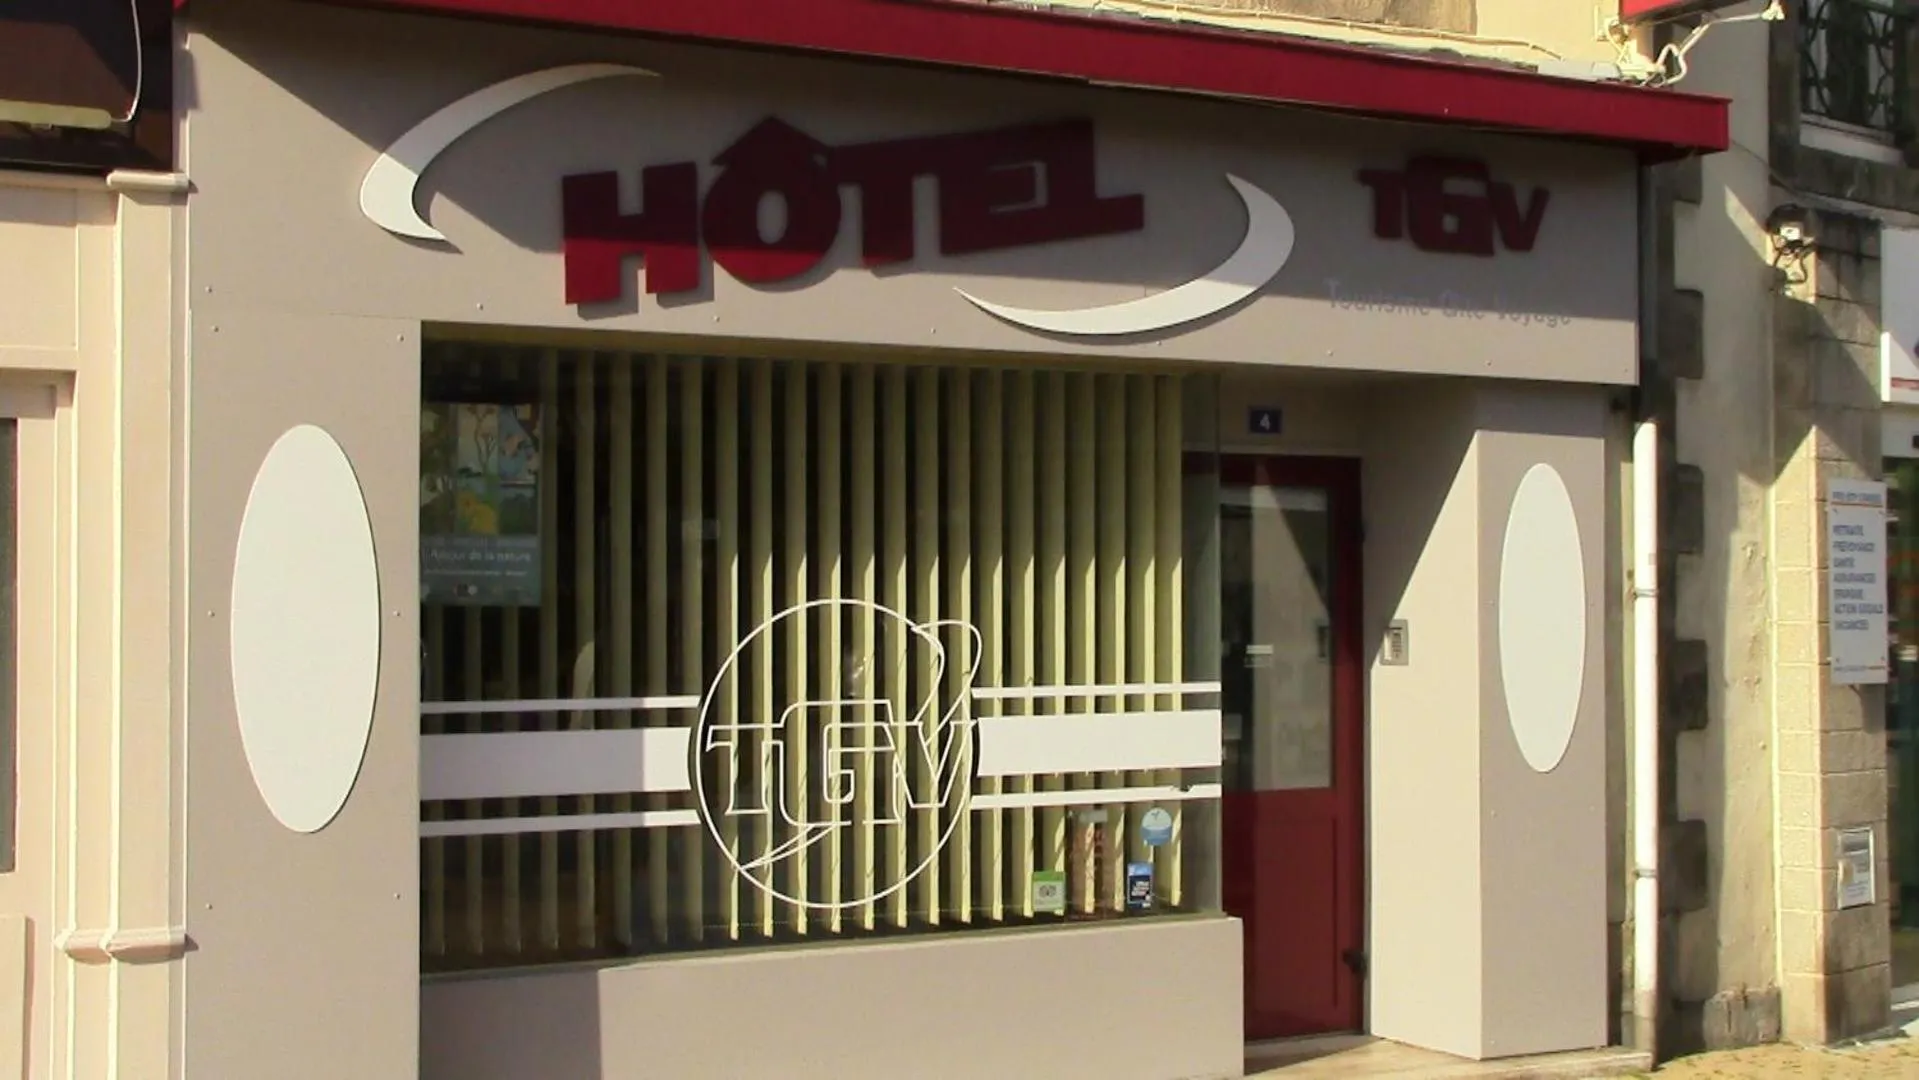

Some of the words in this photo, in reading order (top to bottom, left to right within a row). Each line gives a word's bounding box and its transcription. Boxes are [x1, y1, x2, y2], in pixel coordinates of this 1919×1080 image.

[562, 114, 1144, 306] HÔTEL
[1356, 155, 1550, 258] TGV
[1324, 277, 1431, 317] Tourisme
[1494, 290, 1572, 328] Voyage
[1258, 412, 1271, 431] 4
[705, 695, 978, 828] TGV
